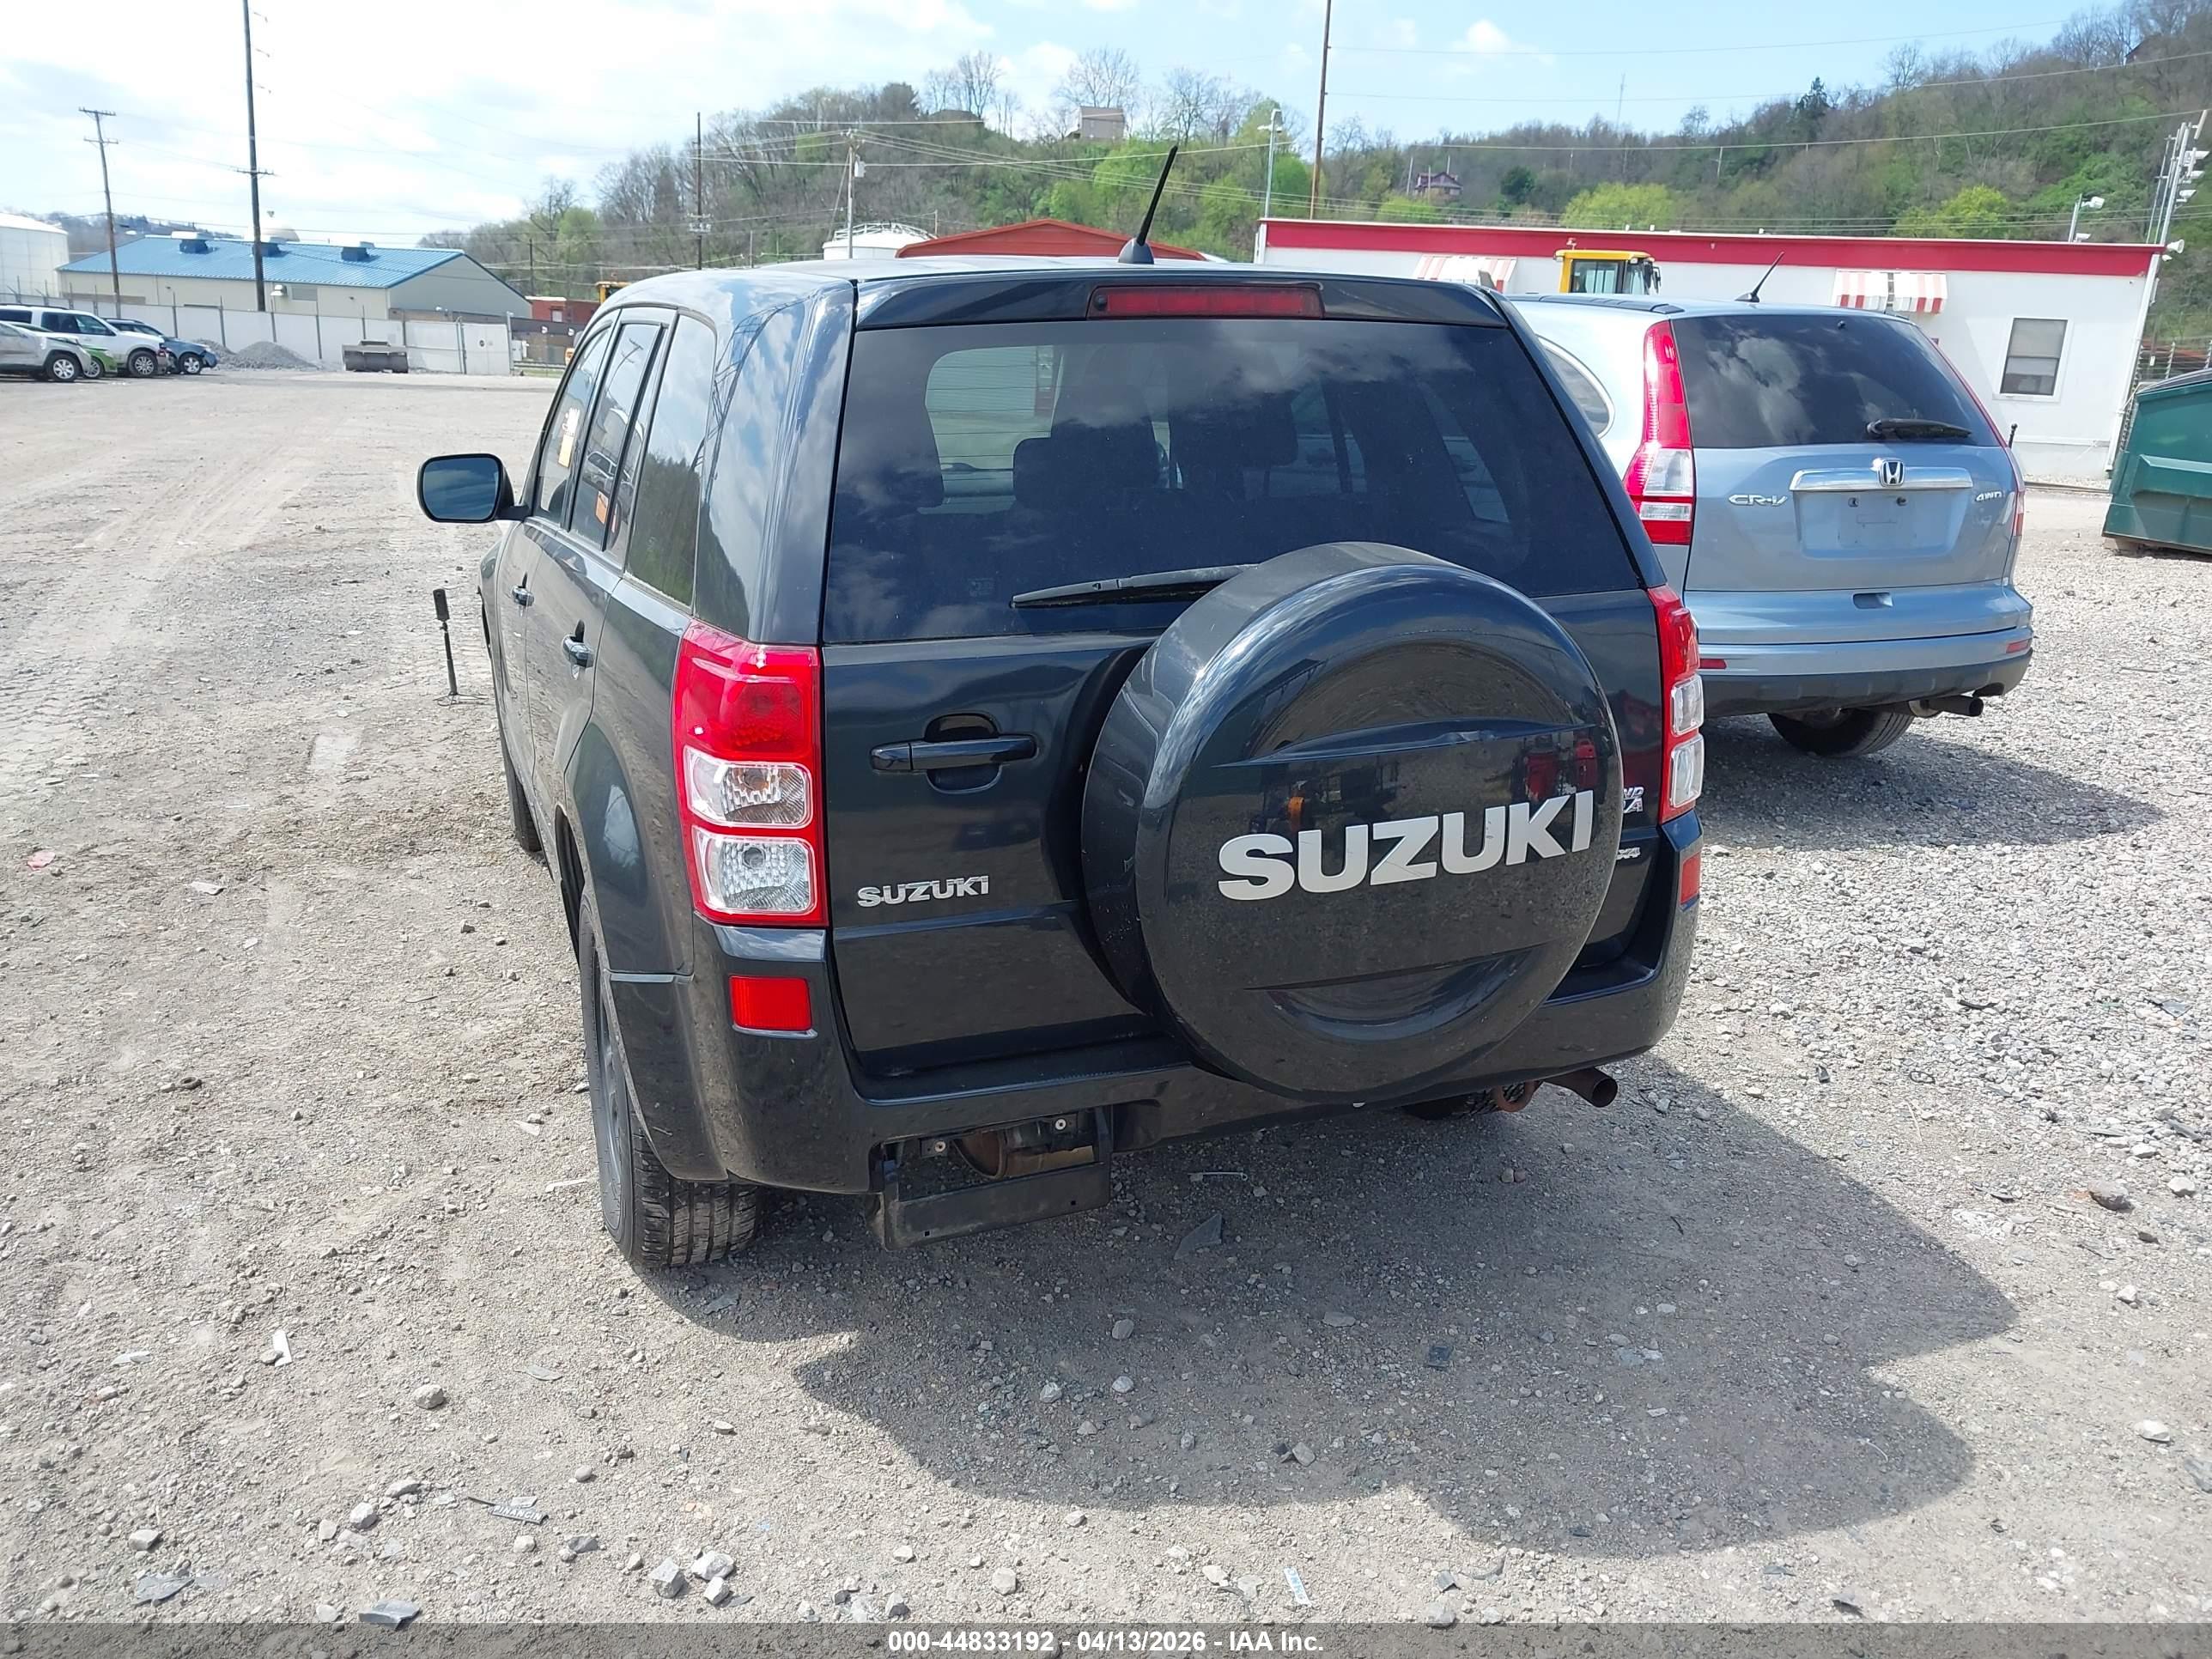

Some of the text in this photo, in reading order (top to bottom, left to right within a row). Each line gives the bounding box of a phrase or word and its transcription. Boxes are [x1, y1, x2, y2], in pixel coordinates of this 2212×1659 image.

[1729, 494, 1787, 506] CR-V
[1976, 491, 2002, 501] 4WD
[1218, 790, 1594, 901] SUZUKI
[858, 875, 989, 908] SUZUKI
